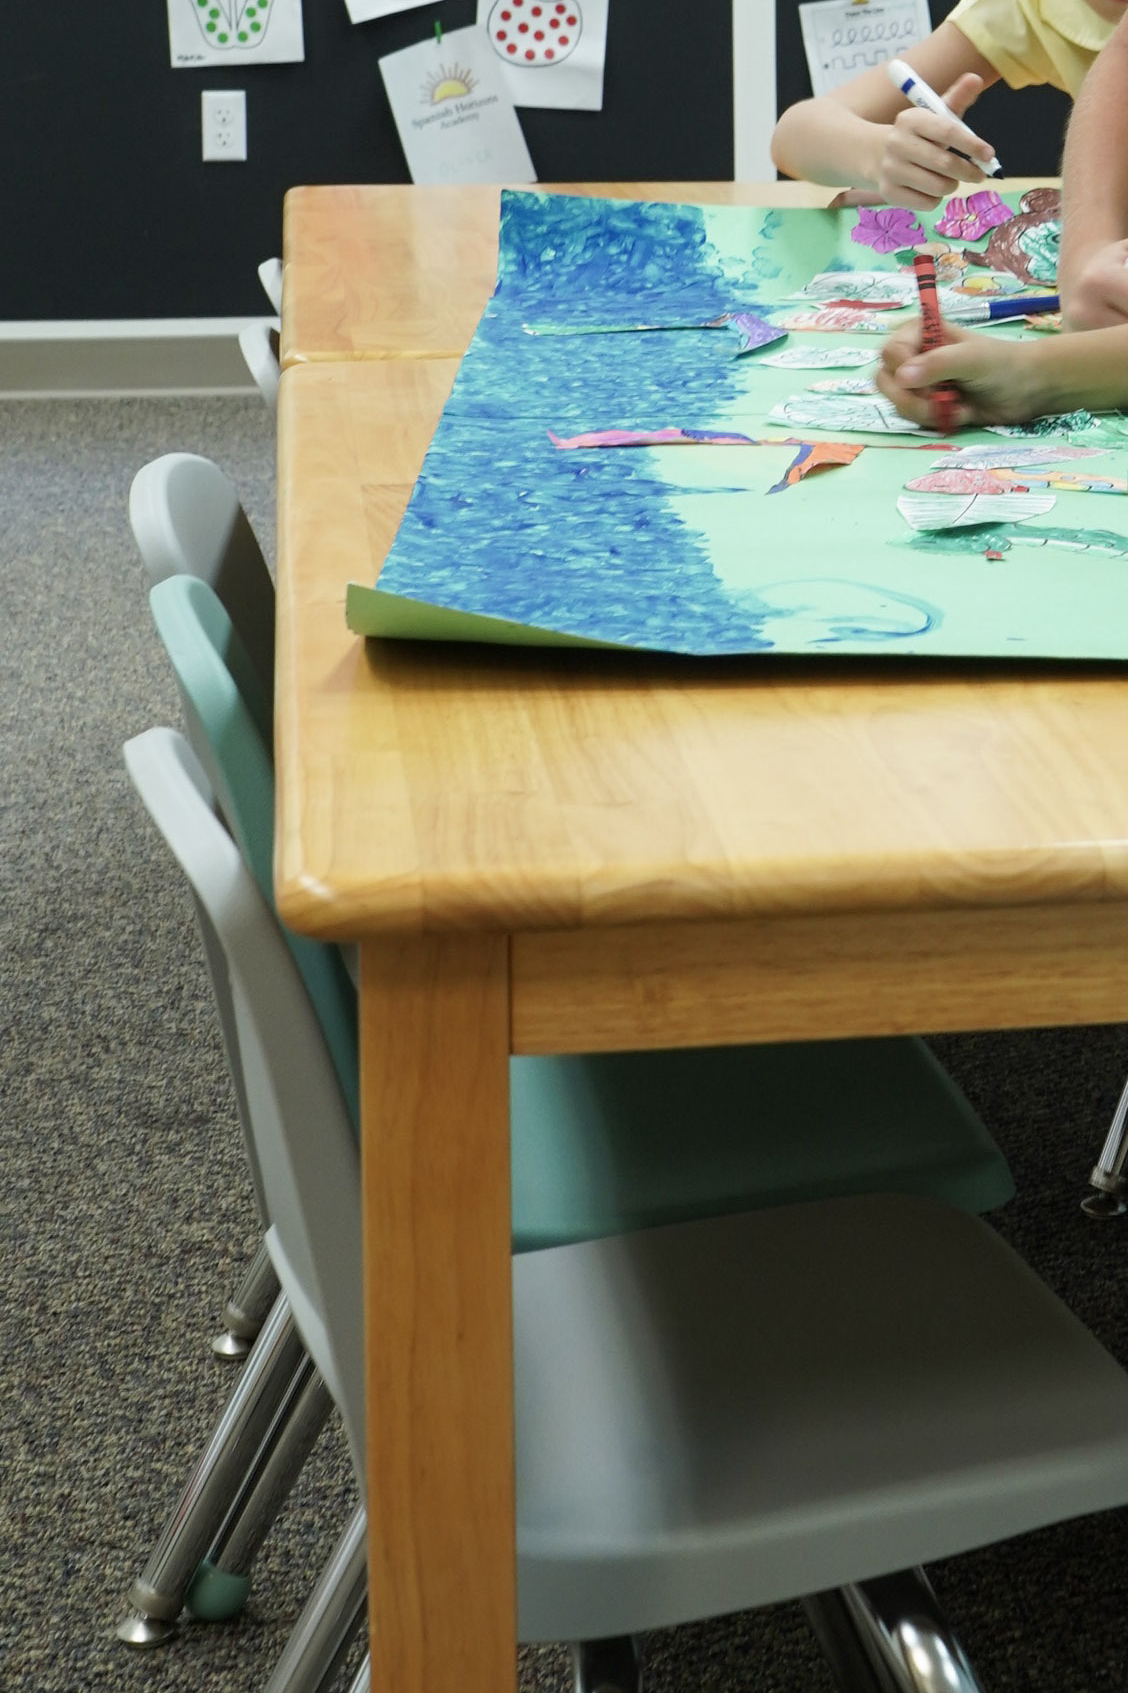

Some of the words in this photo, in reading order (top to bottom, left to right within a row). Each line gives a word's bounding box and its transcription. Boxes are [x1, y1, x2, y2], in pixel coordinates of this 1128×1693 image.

[411, 107, 453, 130] Spanish
[455, 95, 498, 113] Horizons
[441, 112, 479, 130] Academy
